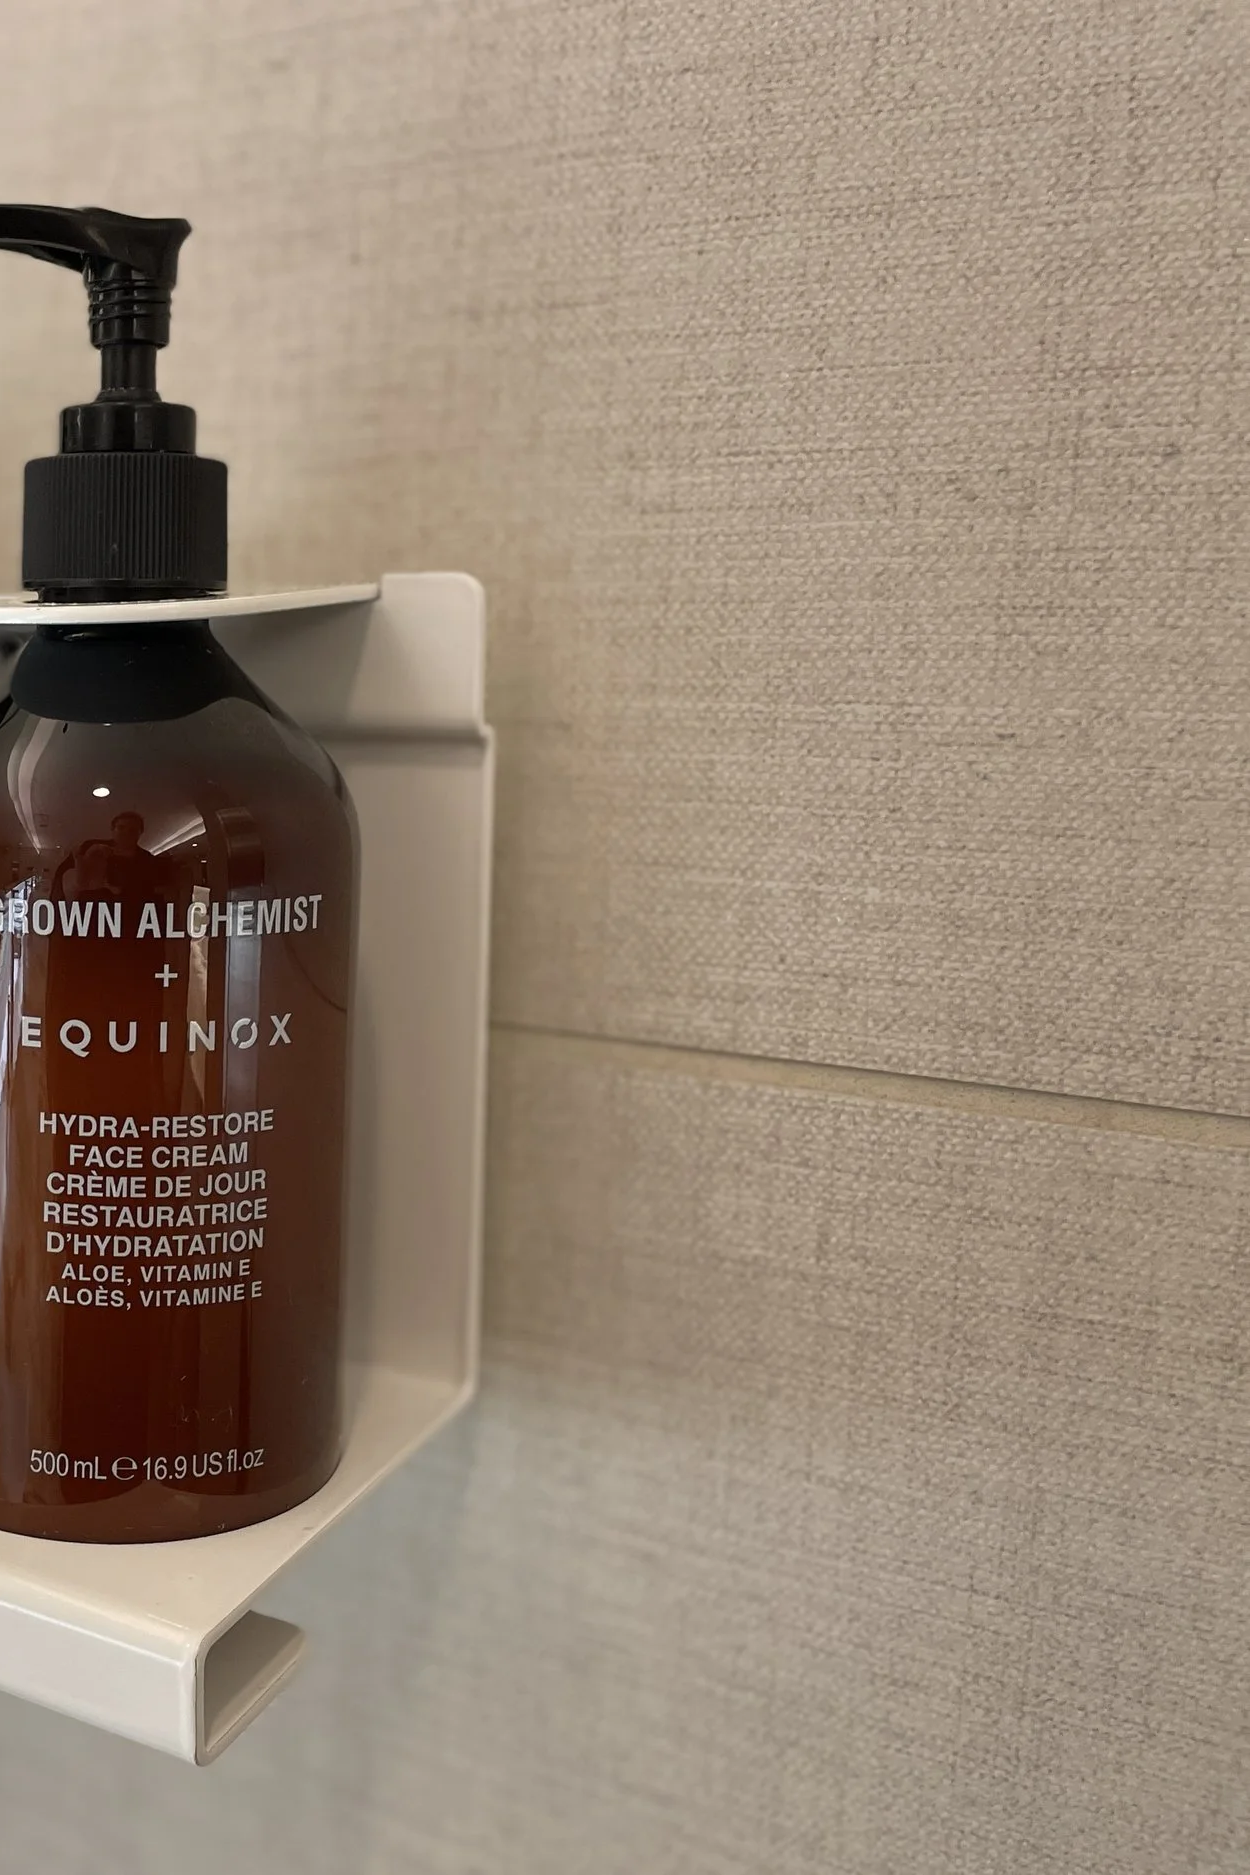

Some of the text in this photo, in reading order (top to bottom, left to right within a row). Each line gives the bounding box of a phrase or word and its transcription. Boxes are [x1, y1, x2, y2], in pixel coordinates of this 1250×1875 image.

[136, 893, 323, 939] ALCHEMIST
[154, 963, 178, 987] +
[21, 1012, 293, 1058] EQUINOX
[39, 1108, 275, 1139] HYDRA-RESTORE
[68, 1141, 248, 1169] FACE CREAM
[46, 1168, 267, 1198] CRÈME DE JOUR
[43, 1197, 268, 1228] RESTAURATRICE
[46, 1227, 264, 1258] D'HYDRATATION
[61, 1258, 251, 1287] ALOE, VITAMIN E
[45, 1280, 263, 1311] ALOÈS, VITAMINE E
[29, 1449, 69, 1477] 500
[73, 1456, 107, 1480] mL
[142, 1455, 187, 1481] 16.9
[192, 1451, 223, 1477] US
